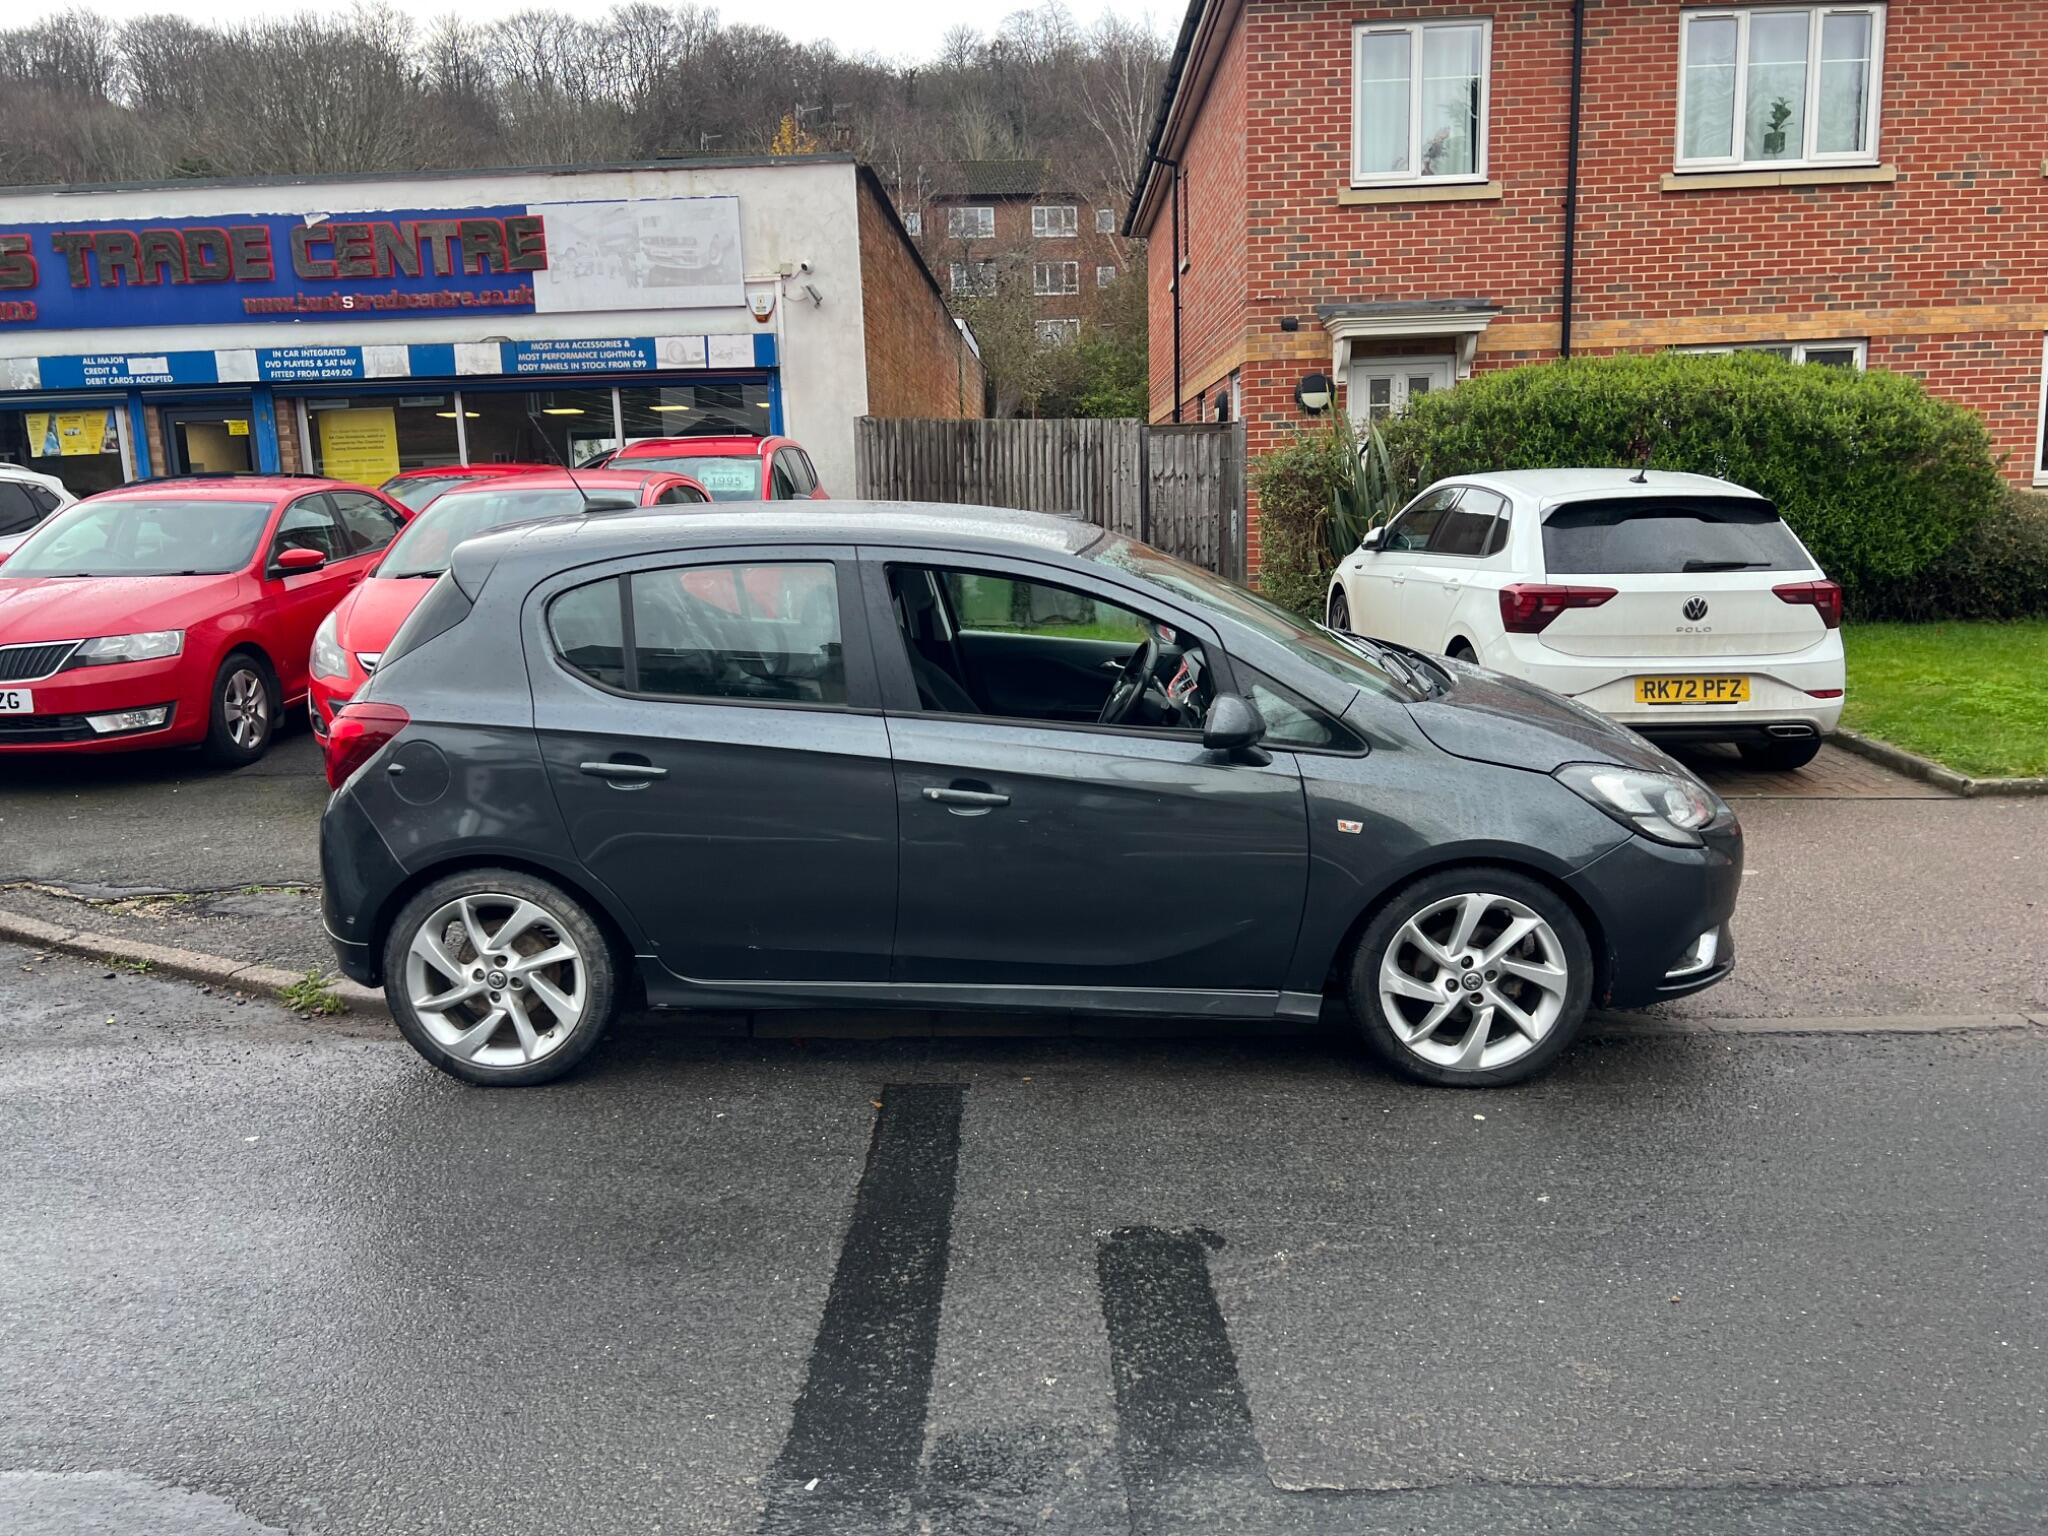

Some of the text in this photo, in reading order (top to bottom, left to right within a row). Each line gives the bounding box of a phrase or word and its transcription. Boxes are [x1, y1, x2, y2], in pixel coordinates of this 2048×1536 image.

[0, 214, 548, 290] S TRADE CENTRE
[531, 340, 630, 351] MOST 4X4 ACCESSORIES &
[272, 348, 347, 358] IN CAR INTEGRATED
[518, 350, 644, 361] MOST PERFORMANCE LIGHTING &
[82, 356, 125, 365] ALL MAJOR
[283, 359, 315, 368] PLAYERS
[316, 359, 323, 367] &
[324, 359, 338, 367] SAT
[340, 358, 357, 366] NAV
[517, 360, 647, 371] BODY PANELS IN STOCK FROM £99
[84, 366, 118, 375] CREDIT &
[270, 369, 353, 378] FITTED FROM £249.00
[85, 375, 174, 385] DEBIT CARDS ACCEPTED
[1675, 625, 1712, 633] POLO
[1643, 679, 1741, 699] RK72 PFZ
